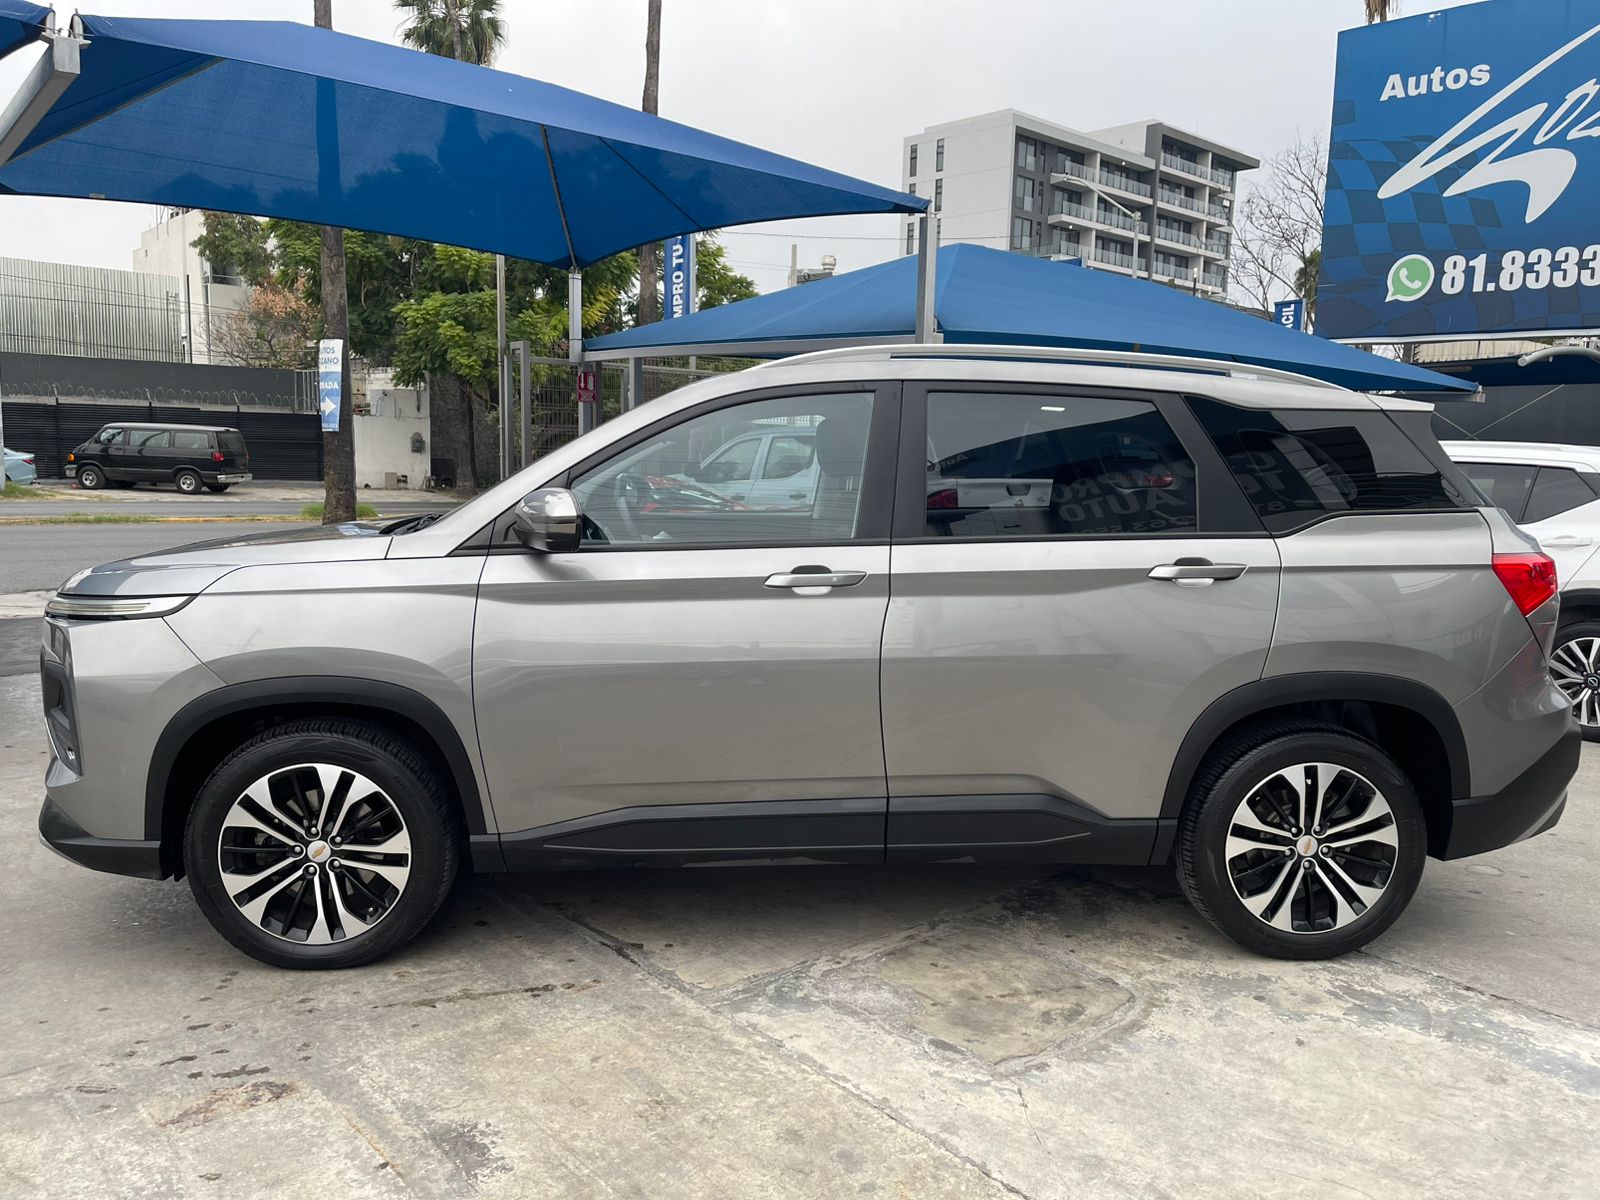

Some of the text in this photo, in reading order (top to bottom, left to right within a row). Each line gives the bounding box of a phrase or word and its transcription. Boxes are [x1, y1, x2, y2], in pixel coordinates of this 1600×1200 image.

[1380, 63, 1491, 102] Autos
[672, 243, 684, 268] TU
[1440, 244, 1600, 295] 81.8333
